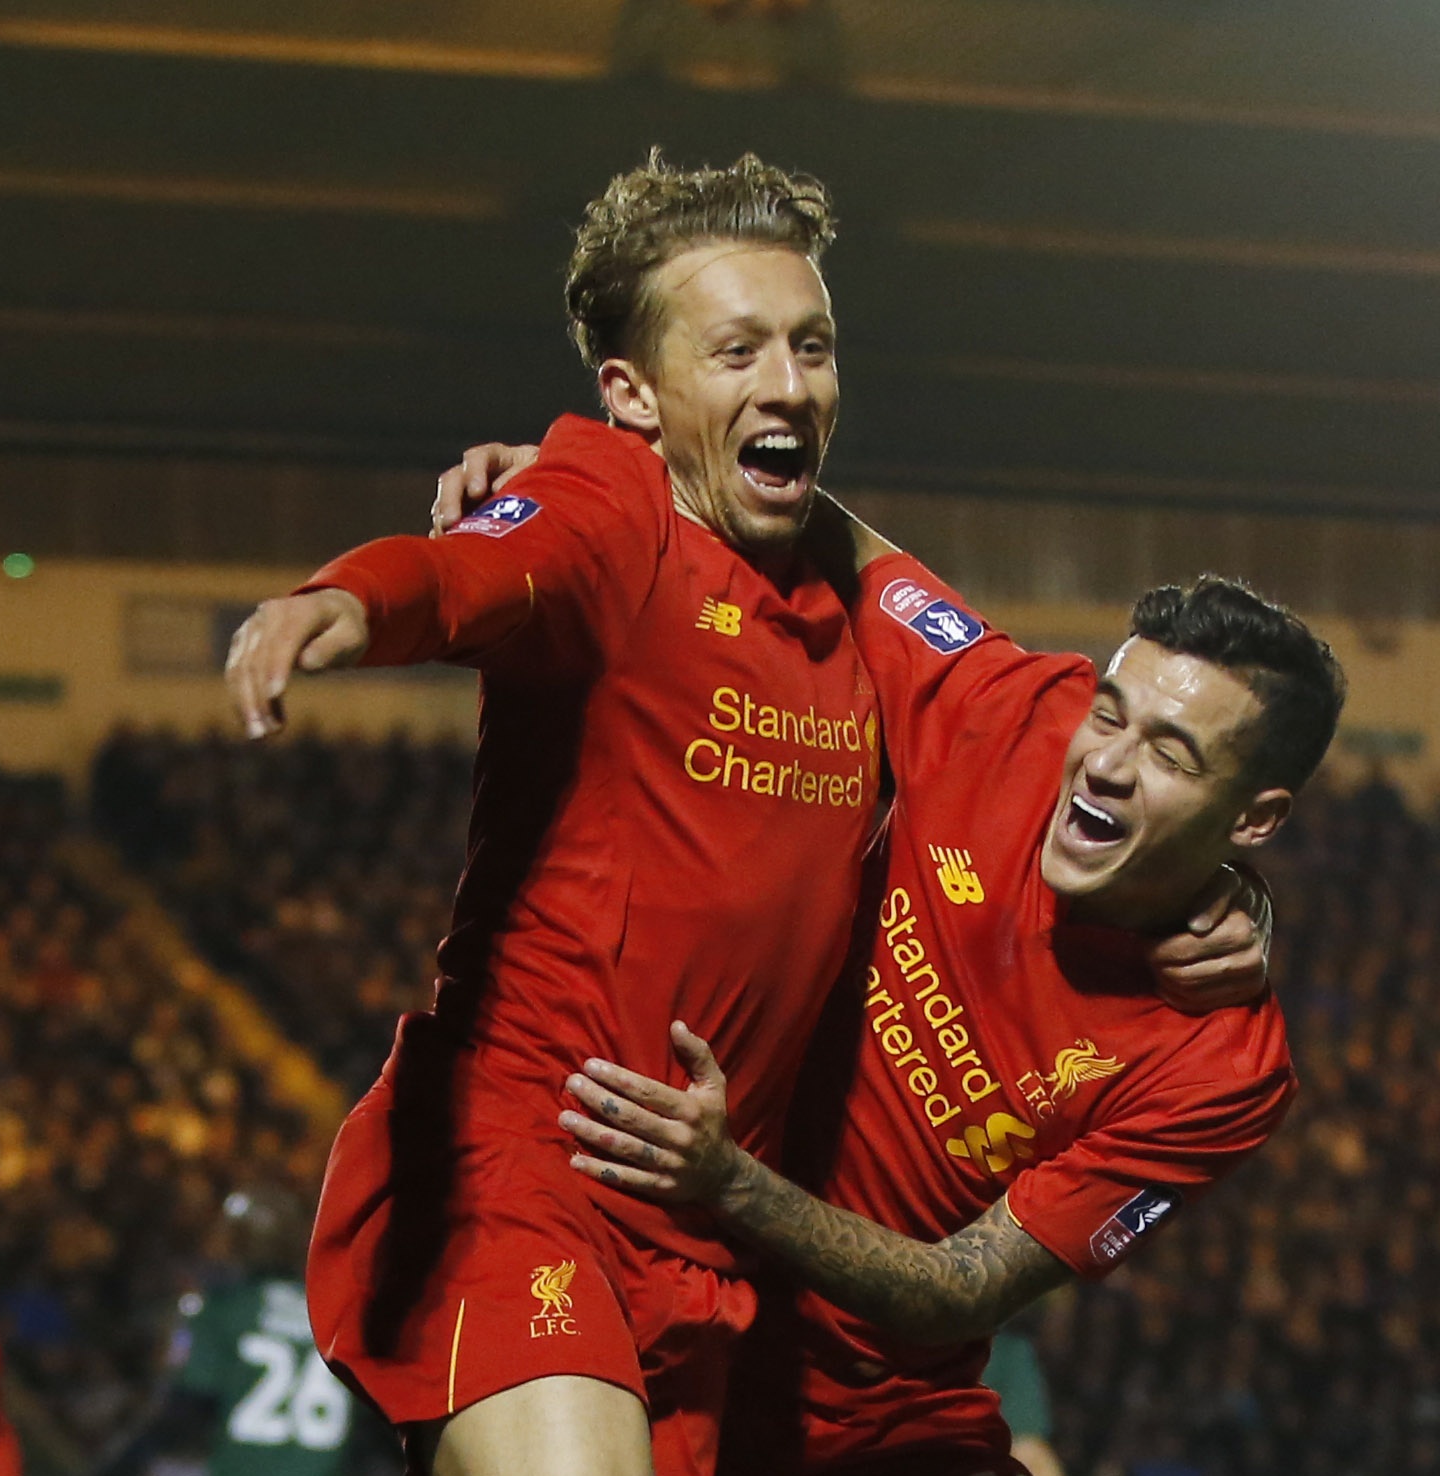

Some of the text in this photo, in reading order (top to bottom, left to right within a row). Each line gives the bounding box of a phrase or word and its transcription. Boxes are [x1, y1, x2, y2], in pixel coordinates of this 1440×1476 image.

[709, 687, 862, 752] Standard
[684, 739, 863, 807] Chartered
[879, 887, 1002, 1104] Standard
[864, 965, 962, 1128] artered
[529, 1318, 582, 1338] L.F.C.
[225, 1334, 354, 1449] 26
